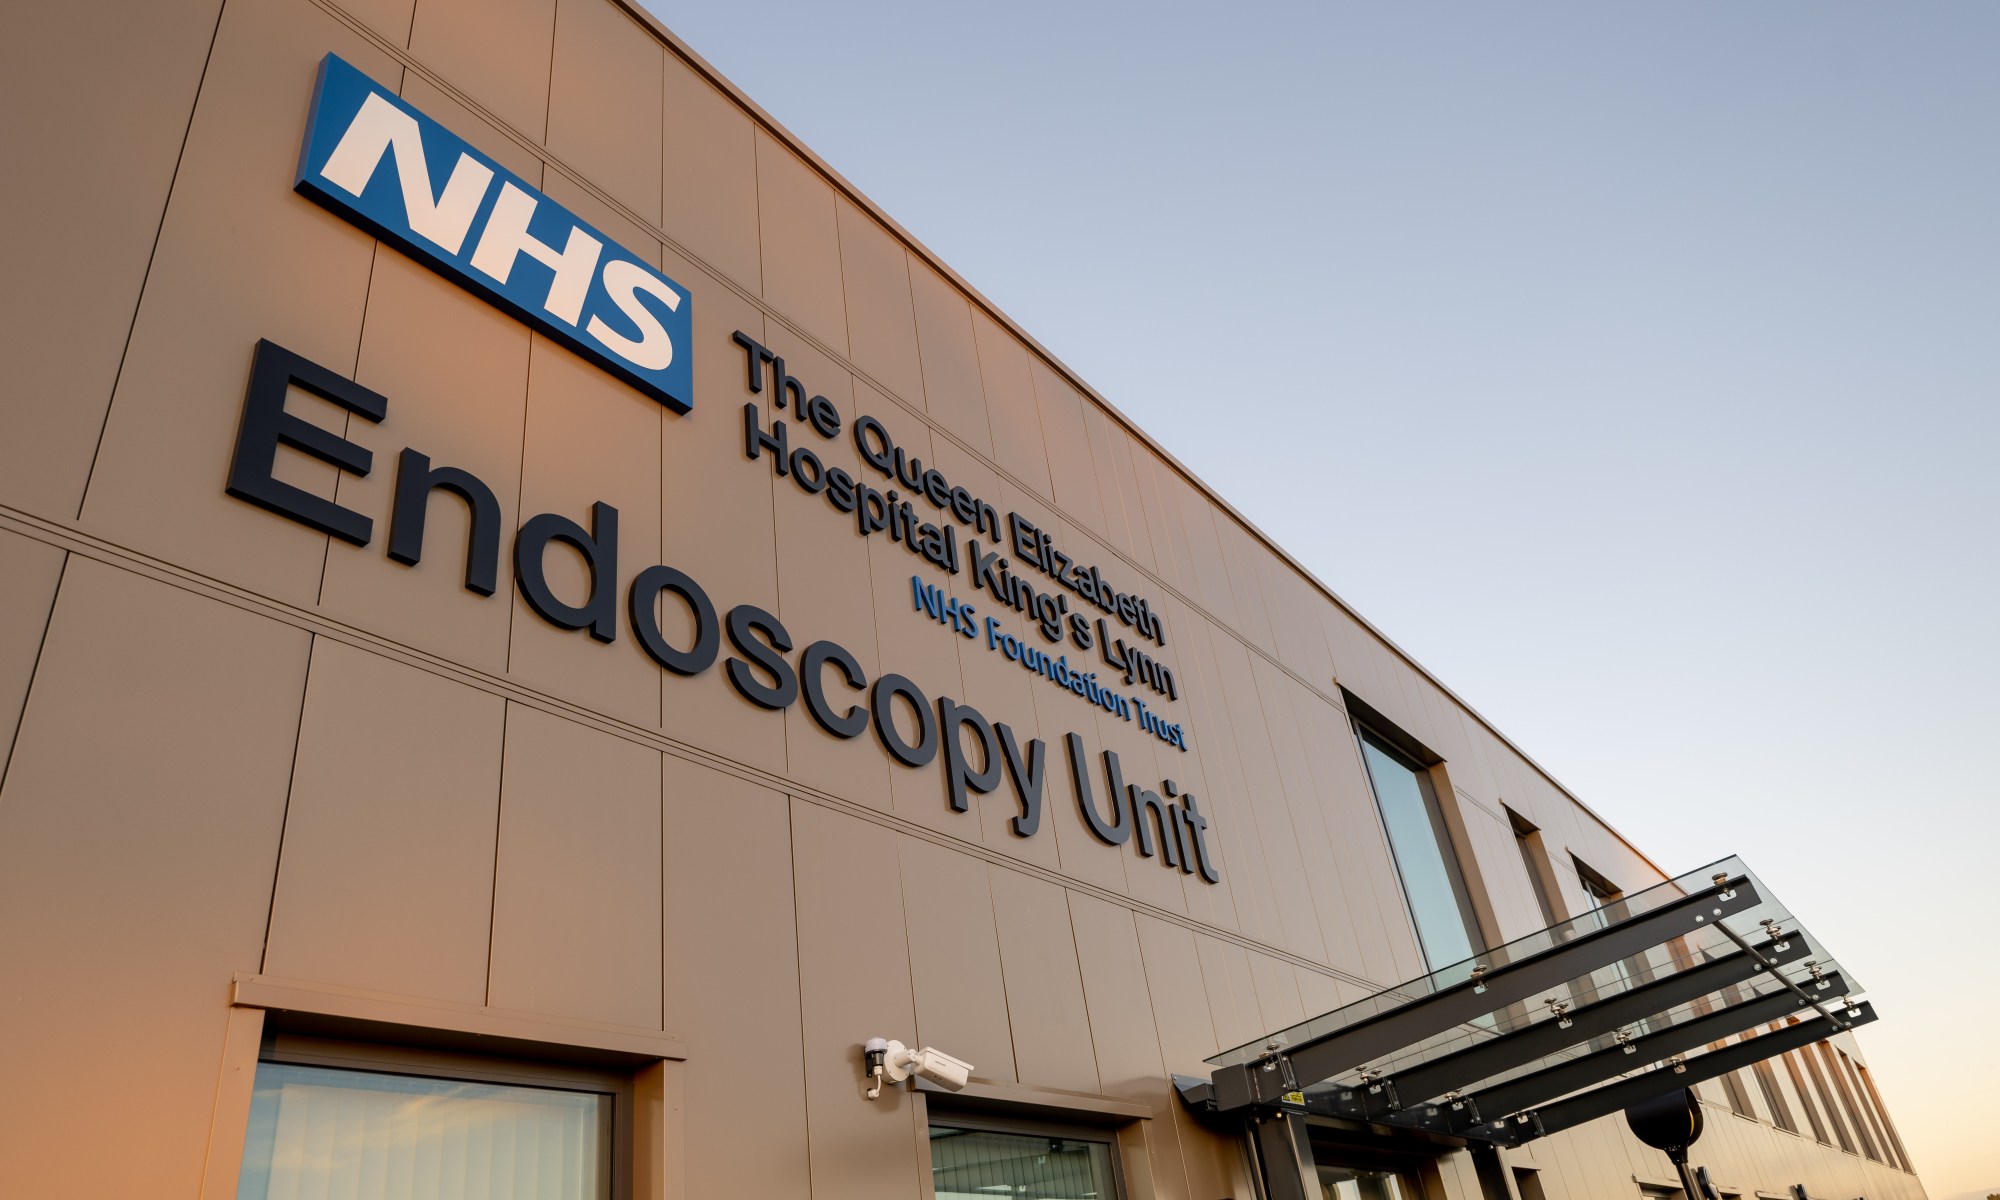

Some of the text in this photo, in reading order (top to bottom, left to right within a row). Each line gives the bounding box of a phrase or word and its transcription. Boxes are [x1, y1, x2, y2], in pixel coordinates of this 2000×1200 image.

[320, 91, 681, 371] NHS
[225, 338, 1220, 885] Endoscopy Unit
[732, 330, 1166, 646] The Queen Elizabeth
[744, 402, 1178, 700] Hospital King's Lynn
[911, 575, 1188, 752] NHS Foundation Trust
